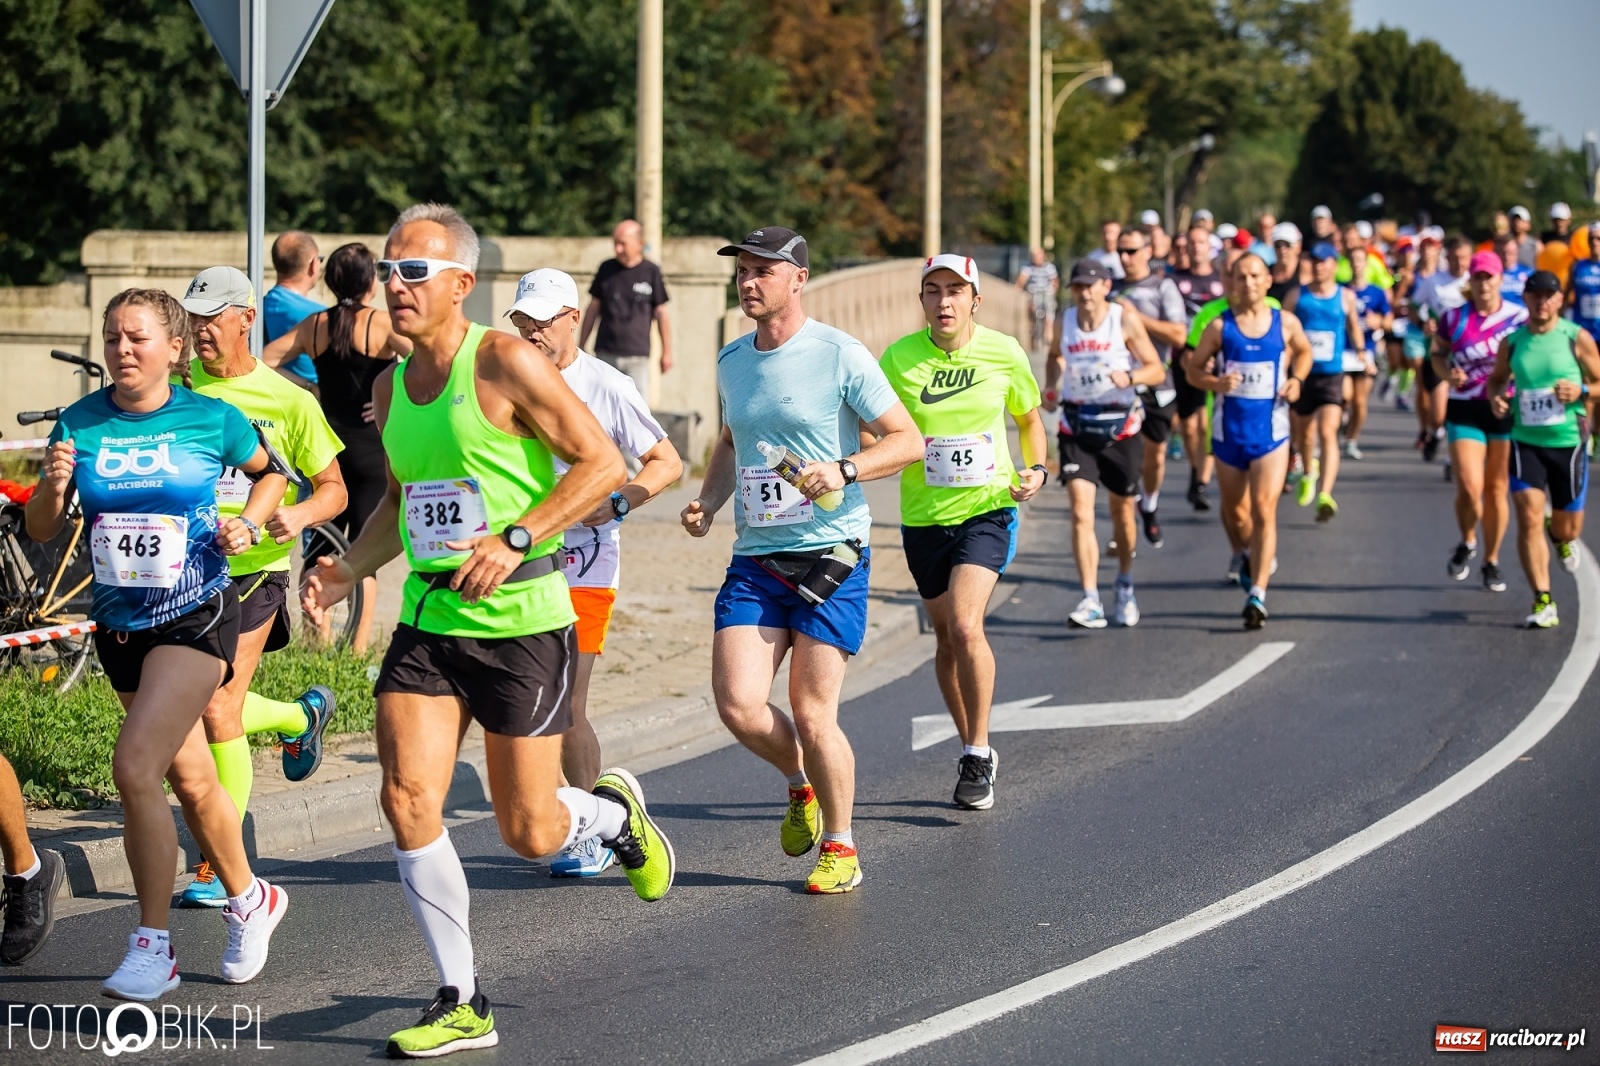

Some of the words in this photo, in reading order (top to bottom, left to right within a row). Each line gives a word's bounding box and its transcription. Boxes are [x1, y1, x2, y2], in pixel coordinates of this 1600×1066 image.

[931, 368, 976, 388] RUN
[95, 443, 179, 477] bbl
[951, 449, 973, 466] 45
[108, 480, 163, 490] RACIBÓRZ
[761, 482, 783, 503] 51
[424, 501, 463, 527] 382
[117, 534, 162, 557] 463
